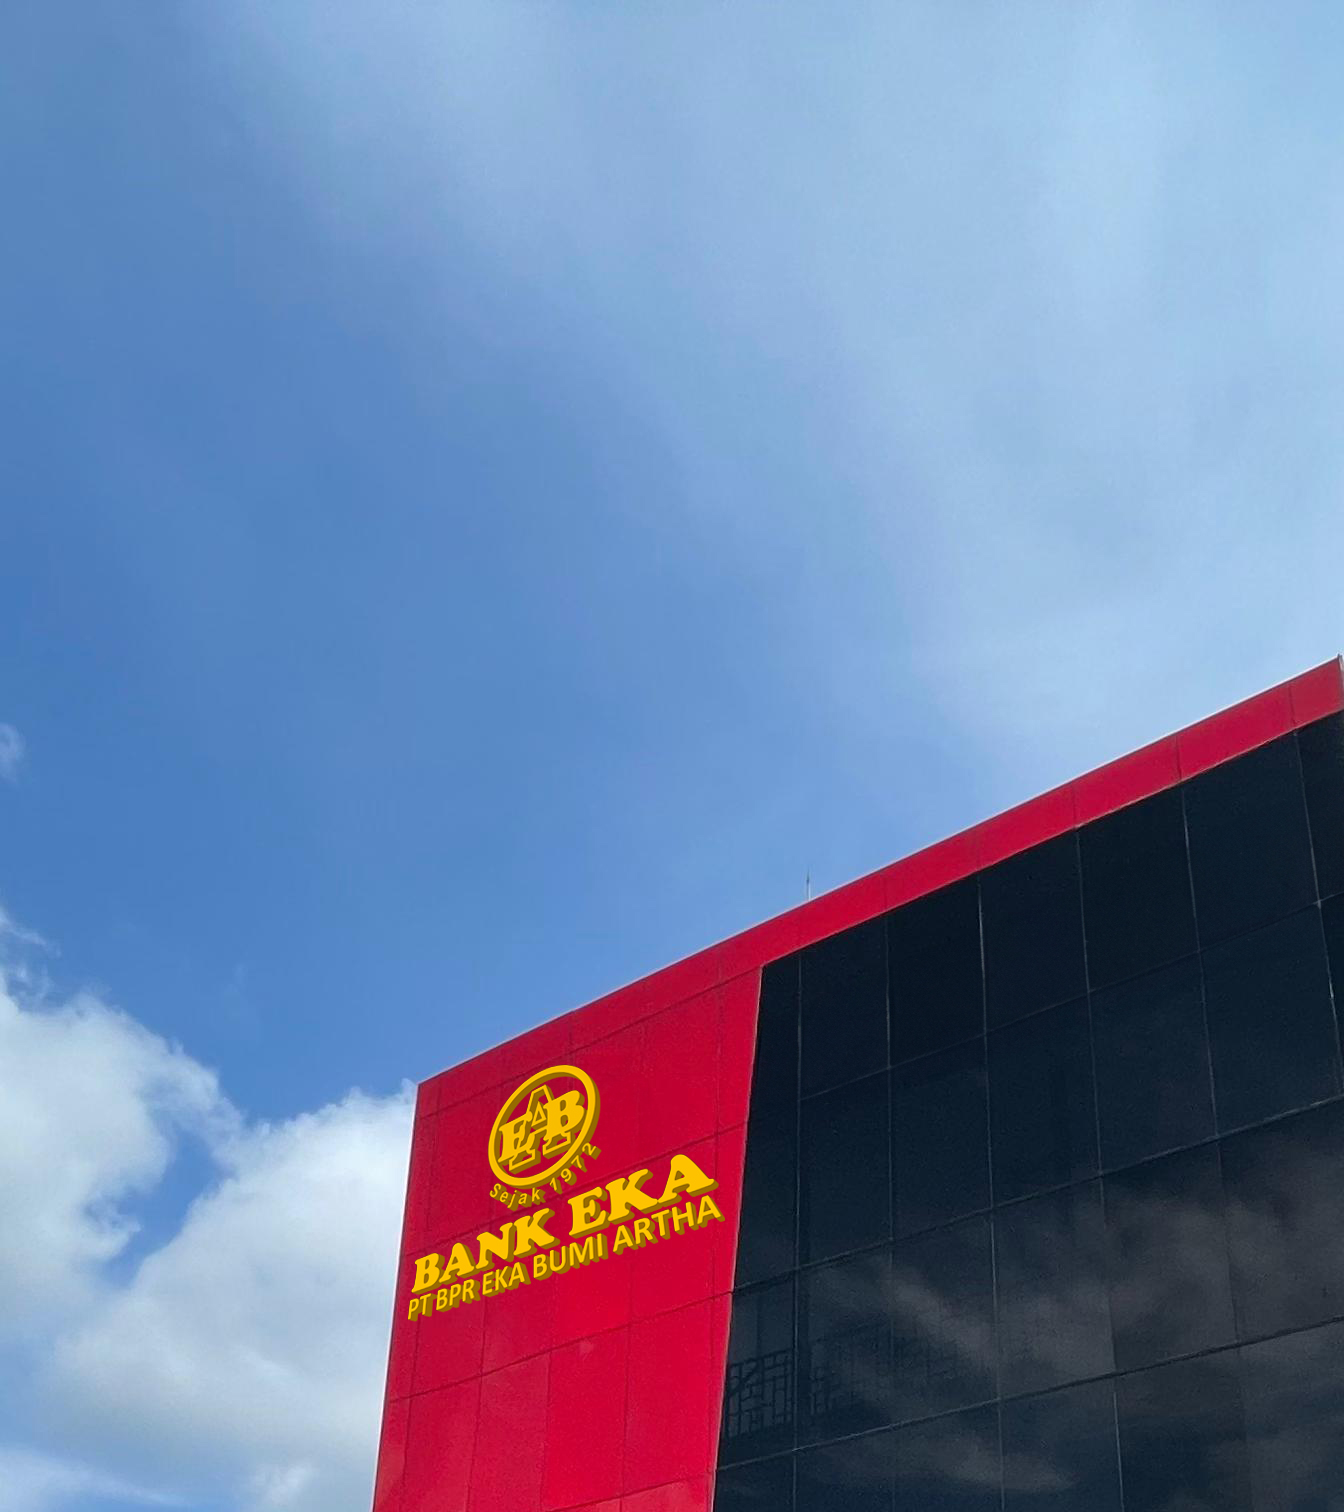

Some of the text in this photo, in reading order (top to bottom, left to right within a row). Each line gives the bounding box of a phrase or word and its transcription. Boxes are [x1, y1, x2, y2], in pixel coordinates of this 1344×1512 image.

[411, 1153, 720, 1295] BANK EKA
[490, 1141, 601, 1211] Sejak 1972
[407, 1195, 725, 1321] PT BPR EKA BUMI ARTHA
